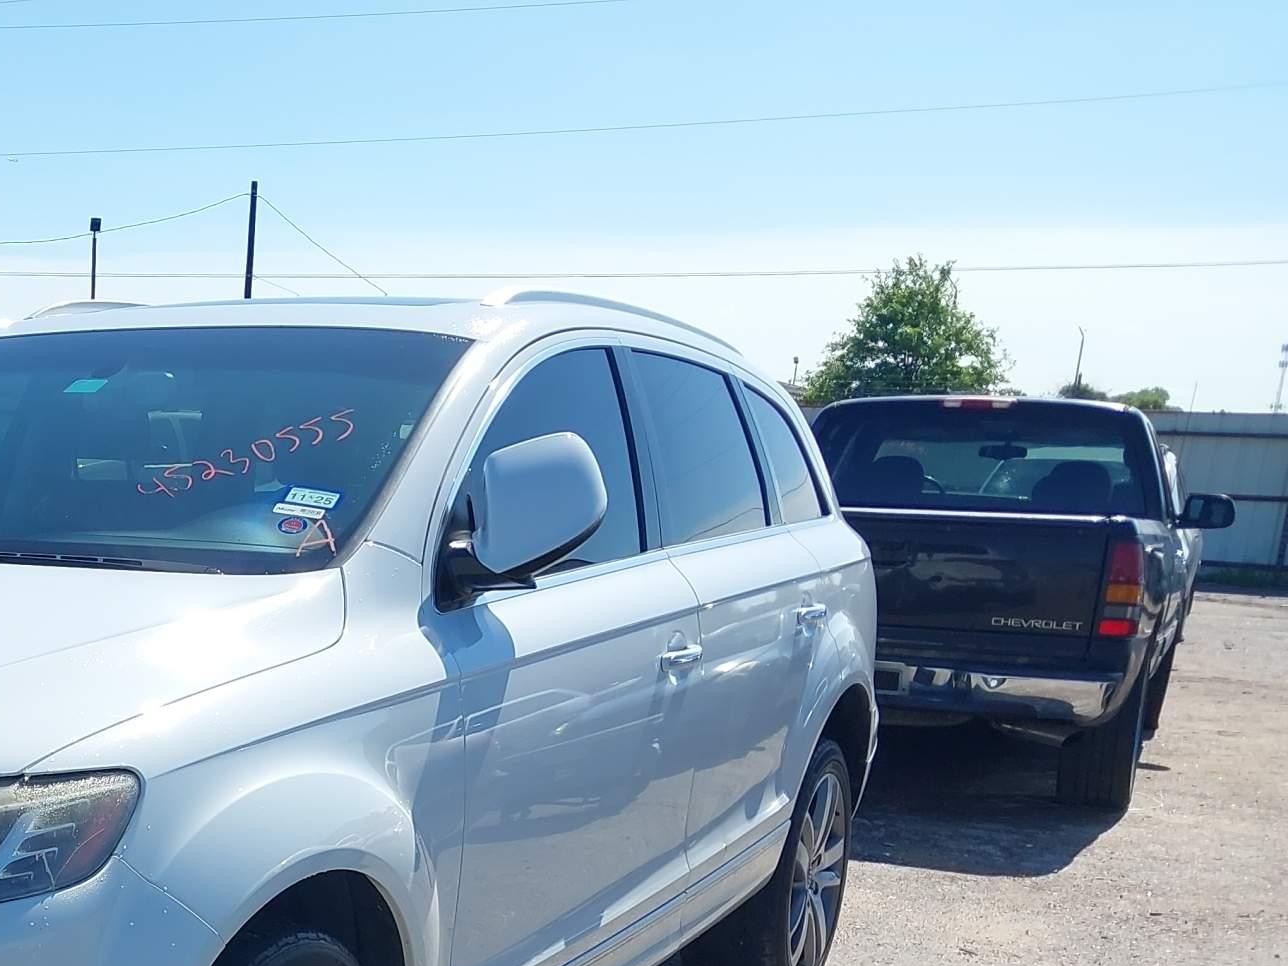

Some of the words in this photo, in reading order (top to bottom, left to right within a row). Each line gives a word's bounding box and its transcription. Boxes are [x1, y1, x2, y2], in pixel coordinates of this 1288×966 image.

[137, 409, 355, 498] 45230555
[291, 492, 306, 501] 11
[313, 495, 334, 505] 25
[296, 519, 336, 557] A
[992, 617, 1083, 631] CHEVROLET
